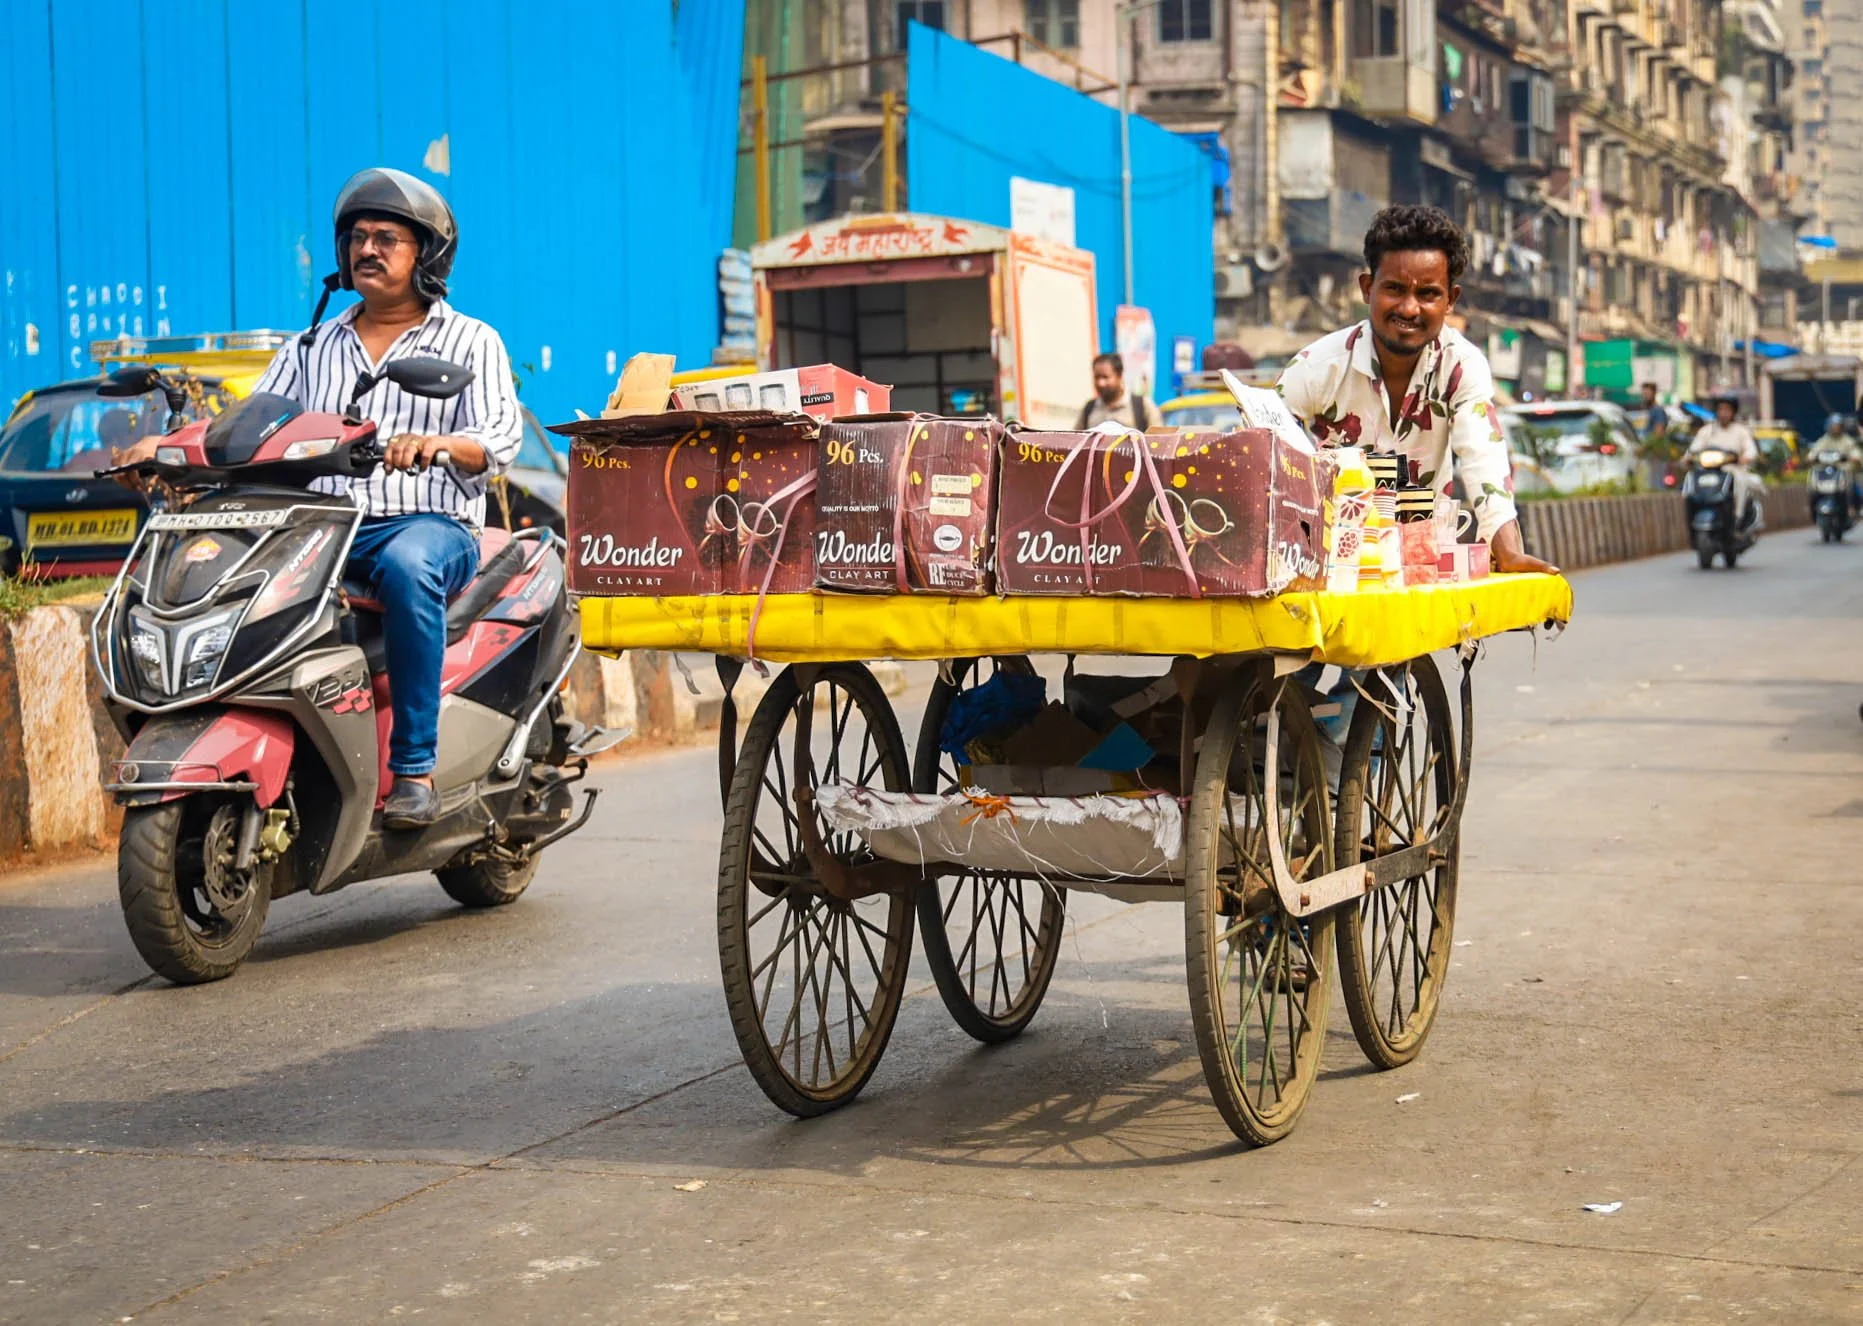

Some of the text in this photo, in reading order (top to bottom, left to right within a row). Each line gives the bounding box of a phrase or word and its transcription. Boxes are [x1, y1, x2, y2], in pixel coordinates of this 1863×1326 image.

[802, 393, 832, 405] QUALITY
[827, 440, 884, 465] 96 Pcs.
[1018, 442, 1042, 463] 96
[608, 458, 632, 469] Pcs.
[821, 505, 843, 513] QUALITY
[860, 505, 879, 513] MOTTO
[580, 534, 683, 567] Wonder
[829, 570, 889, 580] CLAY ART
[928, 563, 947, 585] RE
[1034, 574, 1101, 584] CLAY AT
[597, 576, 663, 586] CLAY ART
